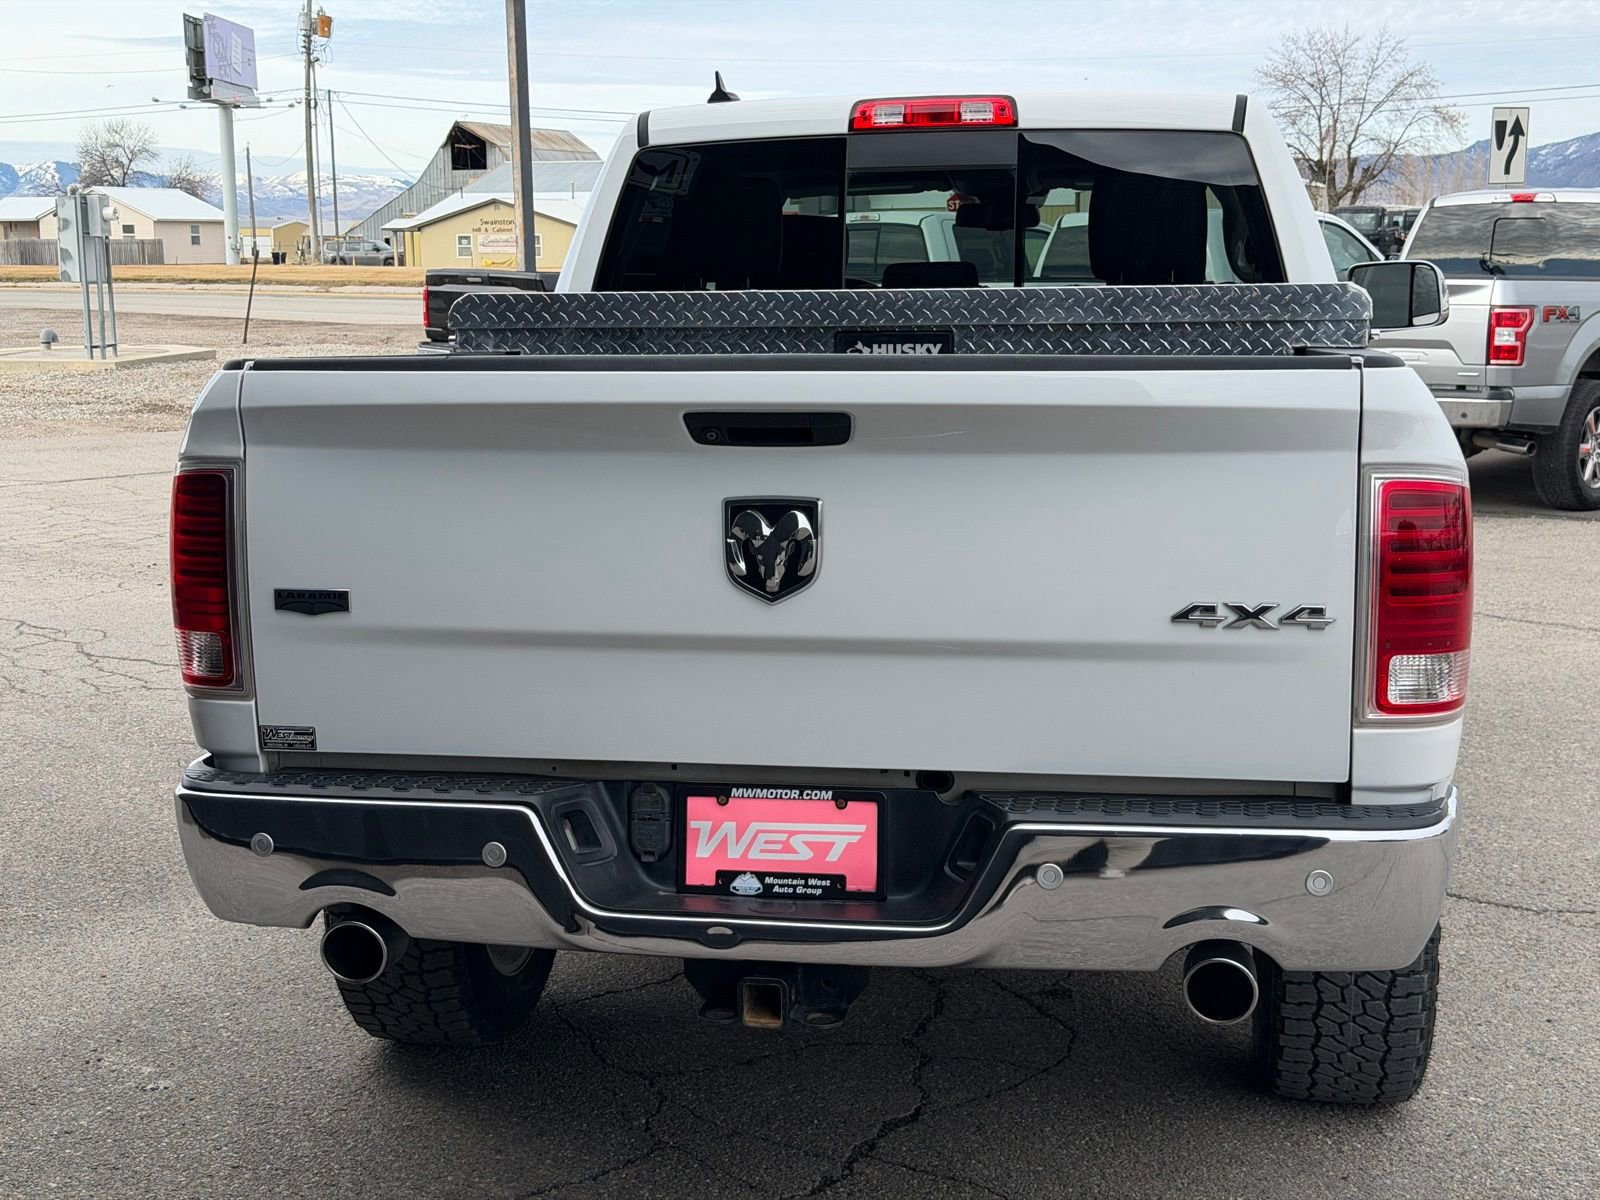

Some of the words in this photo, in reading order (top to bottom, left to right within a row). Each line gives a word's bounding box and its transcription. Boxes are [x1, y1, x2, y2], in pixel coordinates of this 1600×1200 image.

[948, 200, 961, 210] ST
[1543, 305, 1580, 323] FX4
[872, 343, 943, 355] HUSKY
[277, 591, 348, 600] LARAMIE
[731, 788, 833, 801] MWMOTOR.COM
[764, 876, 805, 886] Mountain
[807, 878, 831, 887] West
[772, 885, 794, 894] Auto
[796, 886, 822, 896] Group
